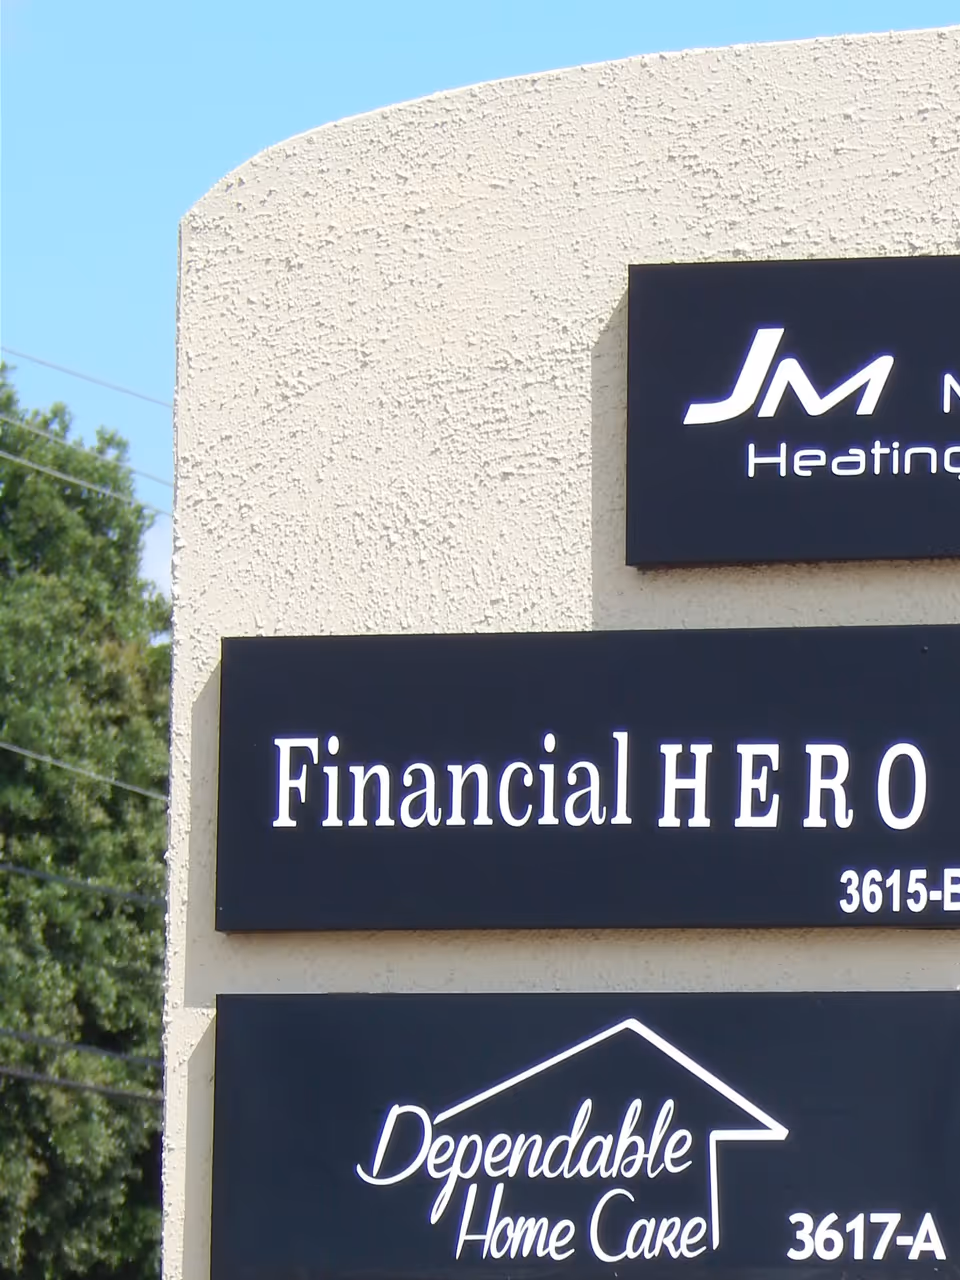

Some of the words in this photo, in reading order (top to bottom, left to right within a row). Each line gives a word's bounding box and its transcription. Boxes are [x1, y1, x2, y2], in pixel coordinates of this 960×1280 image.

[682, 327, 895, 425] JM
[272, 731, 633, 829] Financial
[356, 1098, 693, 1225] Dependable
[455, 1182, 576, 1261] Home
[786, 1212, 947, 1262] 3617-A
